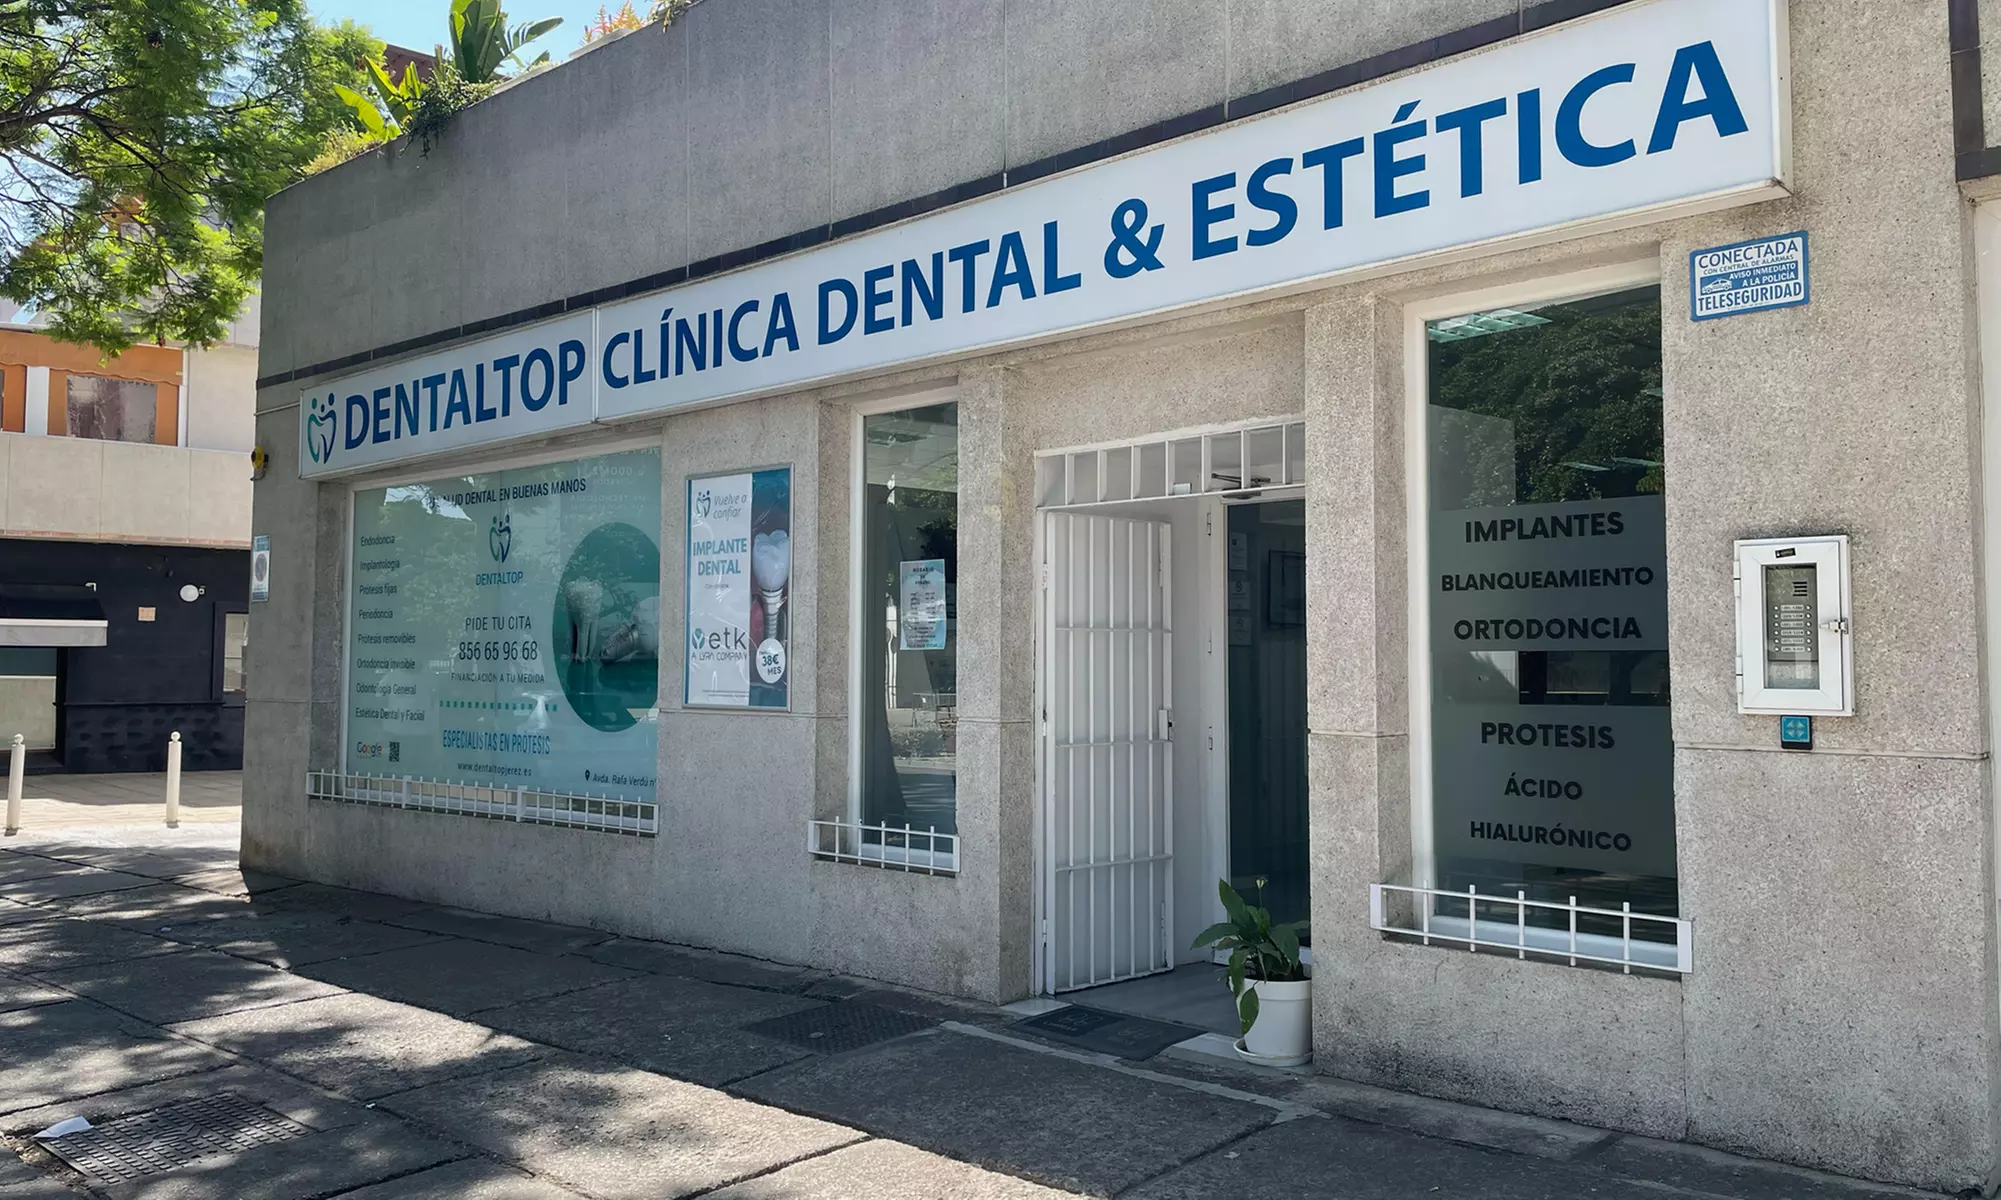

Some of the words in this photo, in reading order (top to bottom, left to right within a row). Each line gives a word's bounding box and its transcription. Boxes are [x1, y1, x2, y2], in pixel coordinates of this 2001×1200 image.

[344, 340, 586, 450] DENTALTOP
[602, 292, 799, 389] CLÍNICA
[817, 221, 1081, 345] DENTAL
[1104, 198, 1165, 279] &
[1192, 40, 1749, 261] ESTÉTICA
[1699, 239, 1798, 269] CONECTADA
[1719, 262, 1749, 273] CENTRAL
[1751, 259, 1760, 267] DE
[1761, 254, 1794, 265] ALARMAS
[1729, 270, 1752, 280] AVISO
[1753, 262, 1796, 276] INMEDIATO
[1742, 279, 1748, 288] A
[1750, 277, 1760, 286] LA
[1698, 281, 1802, 312] TELESEGURIDAD
[465, 490, 497, 506] DENTAL
[500, 487, 510, 501] EN
[512, 483, 549, 499] BUENAS
[551, 478, 587, 495] MANOS
[713, 493, 740, 506] Vuelve
[712, 507, 742, 521] confiar
[1465, 511, 1625, 543] IMPLANTES
[360, 535, 395, 547] Endodoncia
[693, 538, 748, 556] IMPLANTE
[697, 559, 741, 576] DENTAL
[475, 571, 524, 586] DENTALTOP
[1441, 566, 1654, 592] BLANQUEAMIENTO
[359, 609, 393, 619] Periodoncia
[465, 617, 488, 631] PIDE
[492, 616, 505, 630] TU
[508, 615, 532, 630] CITA
[1454, 617, 1643, 640] ORTODONCIA
[383, 632, 416, 644] removibles
[708, 627, 747, 650] etk
[459, 641, 481, 661] 856
[484, 641, 499, 661] 65
[503, 641, 518, 660] 96
[522, 641, 538, 660] 68
[716, 653, 748, 661] COMPANY
[357, 658, 389, 669] Ortodoncia
[390, 658, 415, 669] invisible
[761, 654, 780, 667] 38€
[500, 673, 505, 682] A
[507, 673, 516, 683] TU
[518, 673, 545, 683] MEDIDA
[767, 667, 782, 676] MES
[392, 683, 417, 695] General
[380, 708, 400, 720] Dental
[401, 712, 406, 723] y
[406, 709, 425, 721] Facial
[442, 729, 498, 751] ESPECIALISTAS
[500, 733, 510, 752] EN
[1481, 722, 1615, 749] PROTESIS
[612, 774, 627, 785] Rafa
[1504, 772, 1583, 801] ÁCIDO
[1470, 821, 1632, 852] HIALURÓNICO
